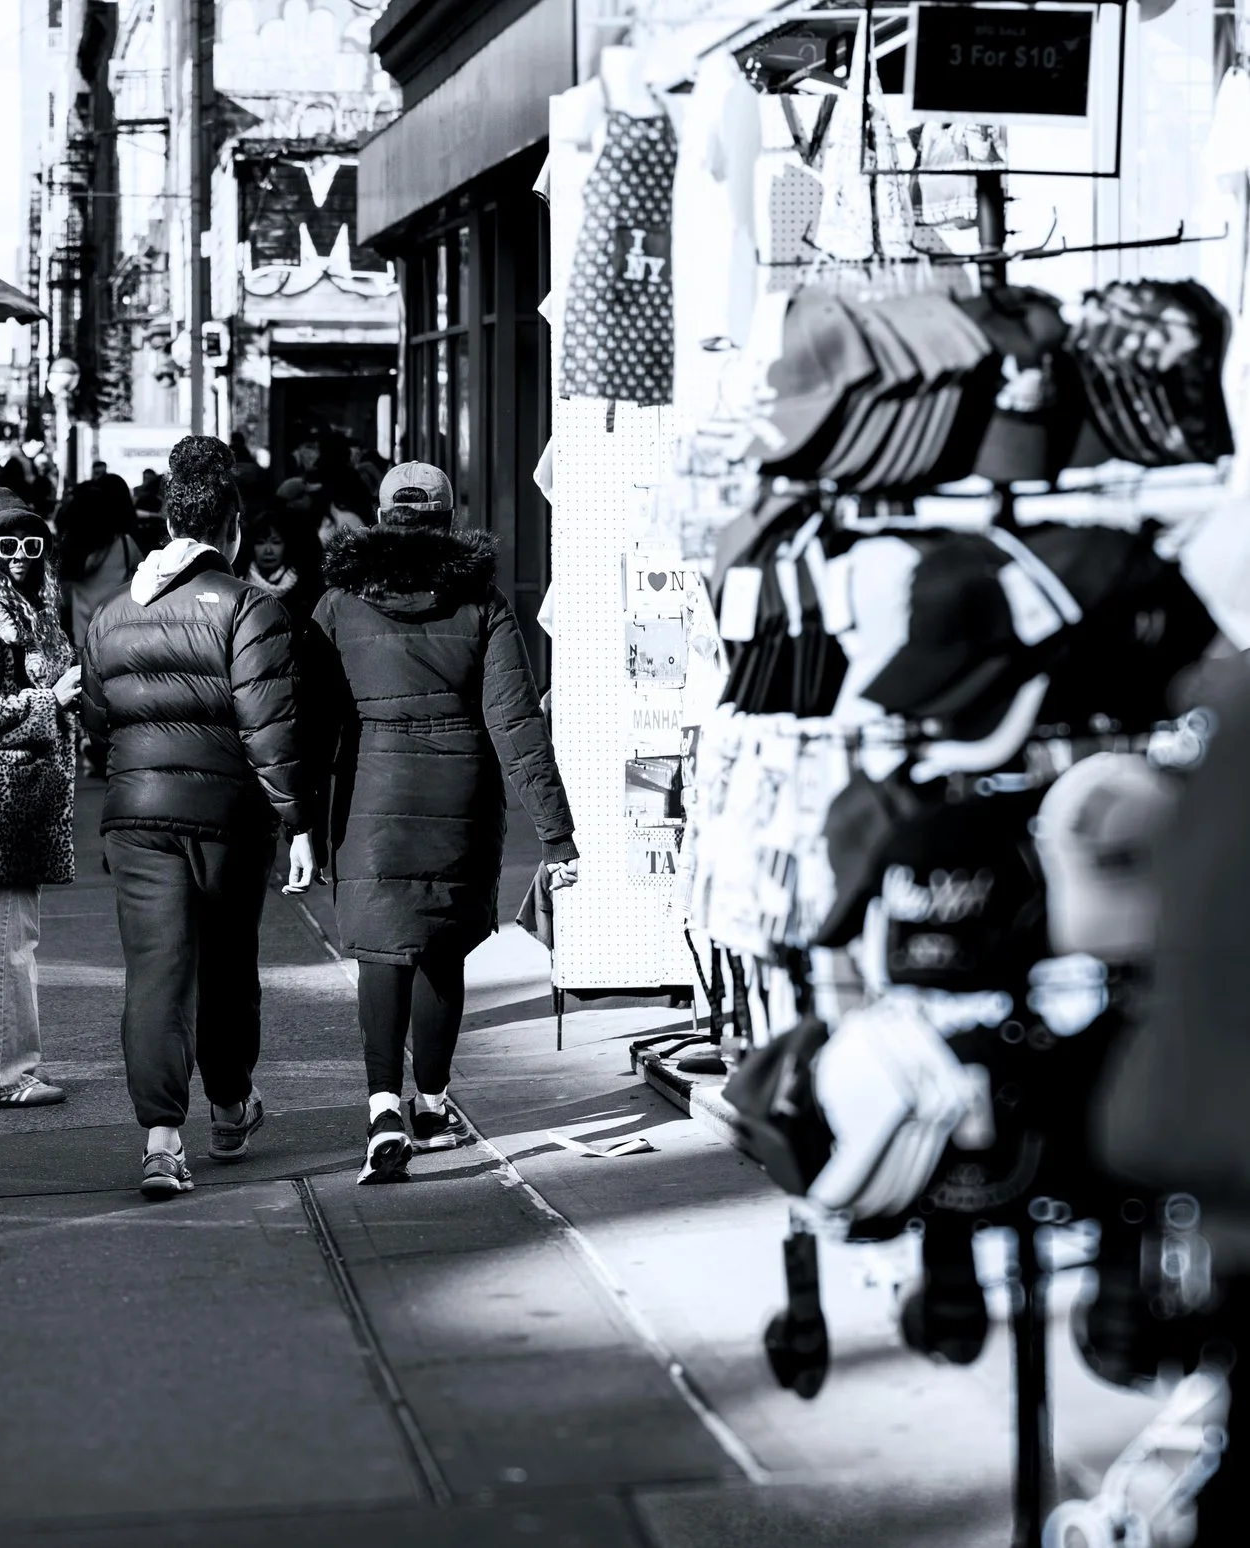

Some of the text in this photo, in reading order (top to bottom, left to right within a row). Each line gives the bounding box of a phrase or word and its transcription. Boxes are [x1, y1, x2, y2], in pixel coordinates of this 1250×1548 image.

[949, 43, 963, 66] 3
[971, 44, 1007, 67] For
[623, 253, 667, 284] NY
[636, 570, 644, 591] I
